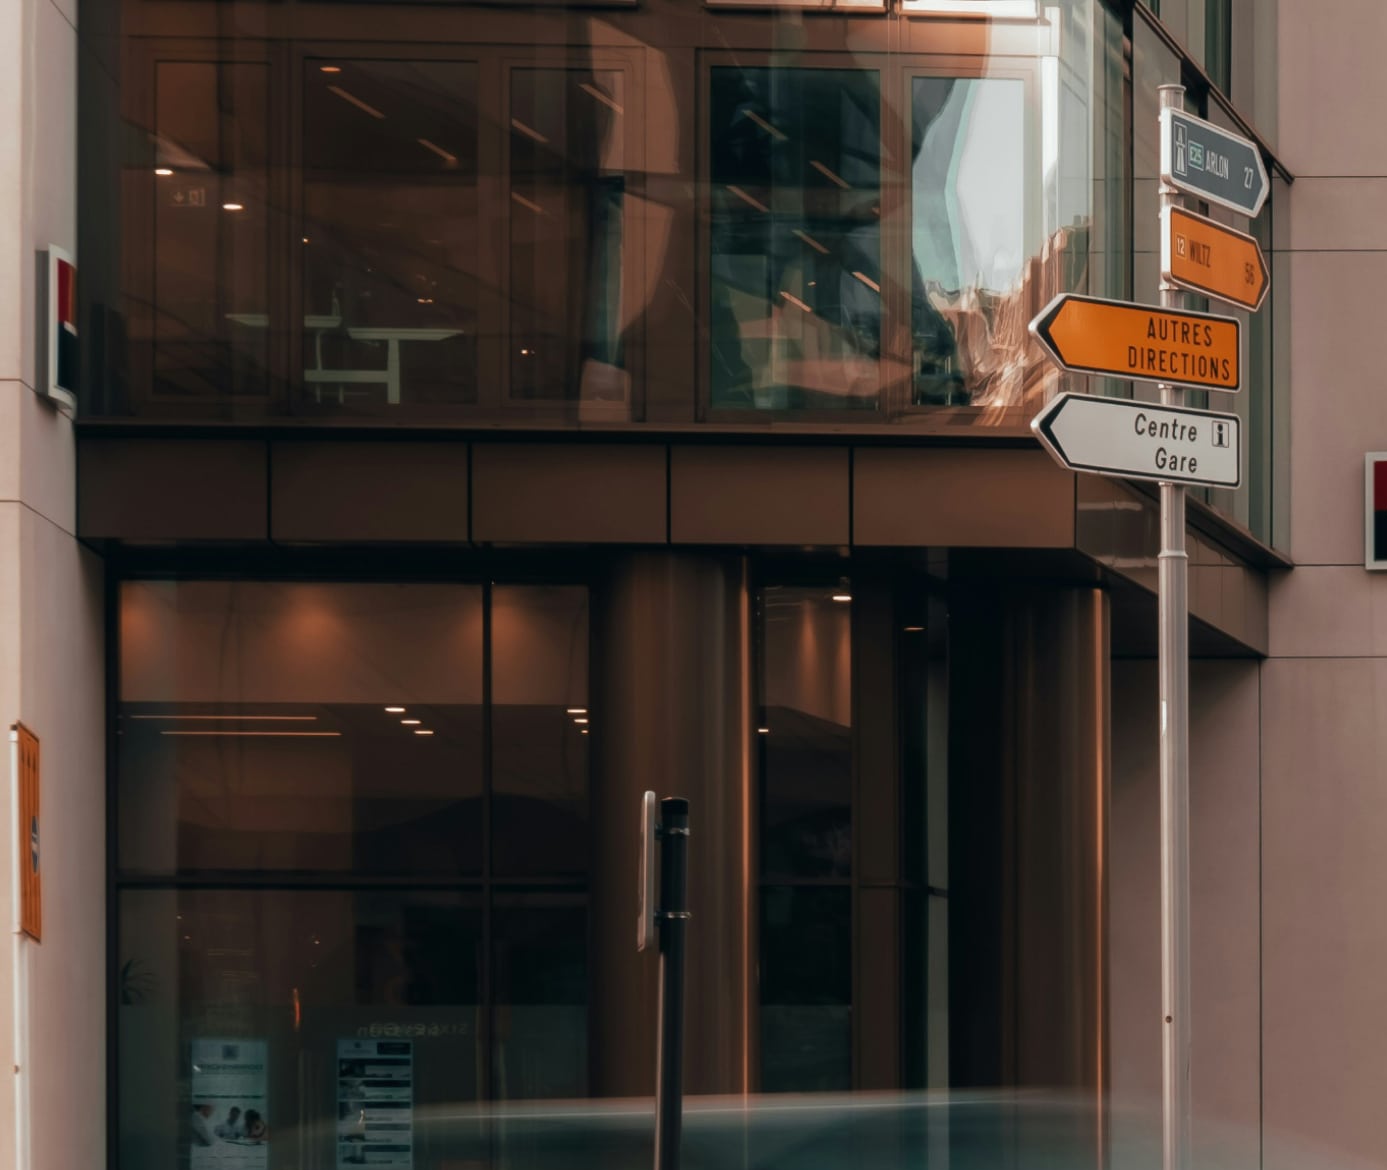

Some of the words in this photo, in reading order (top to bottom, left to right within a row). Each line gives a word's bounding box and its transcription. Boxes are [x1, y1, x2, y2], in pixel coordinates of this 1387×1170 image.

[1205, 150, 1229, 180] ARLON
[1244, 166, 1254, 190] 27
[1176, 237, 1185, 256] 12
[1189, 239, 1211, 269] WILTZ
[1147, 317, 1213, 347] AUTRES
[1128, 345, 1230, 381] DIRECTIONS
[1134, 413, 1198, 442] Centre
[1155, 447, 1198, 474] Gare
